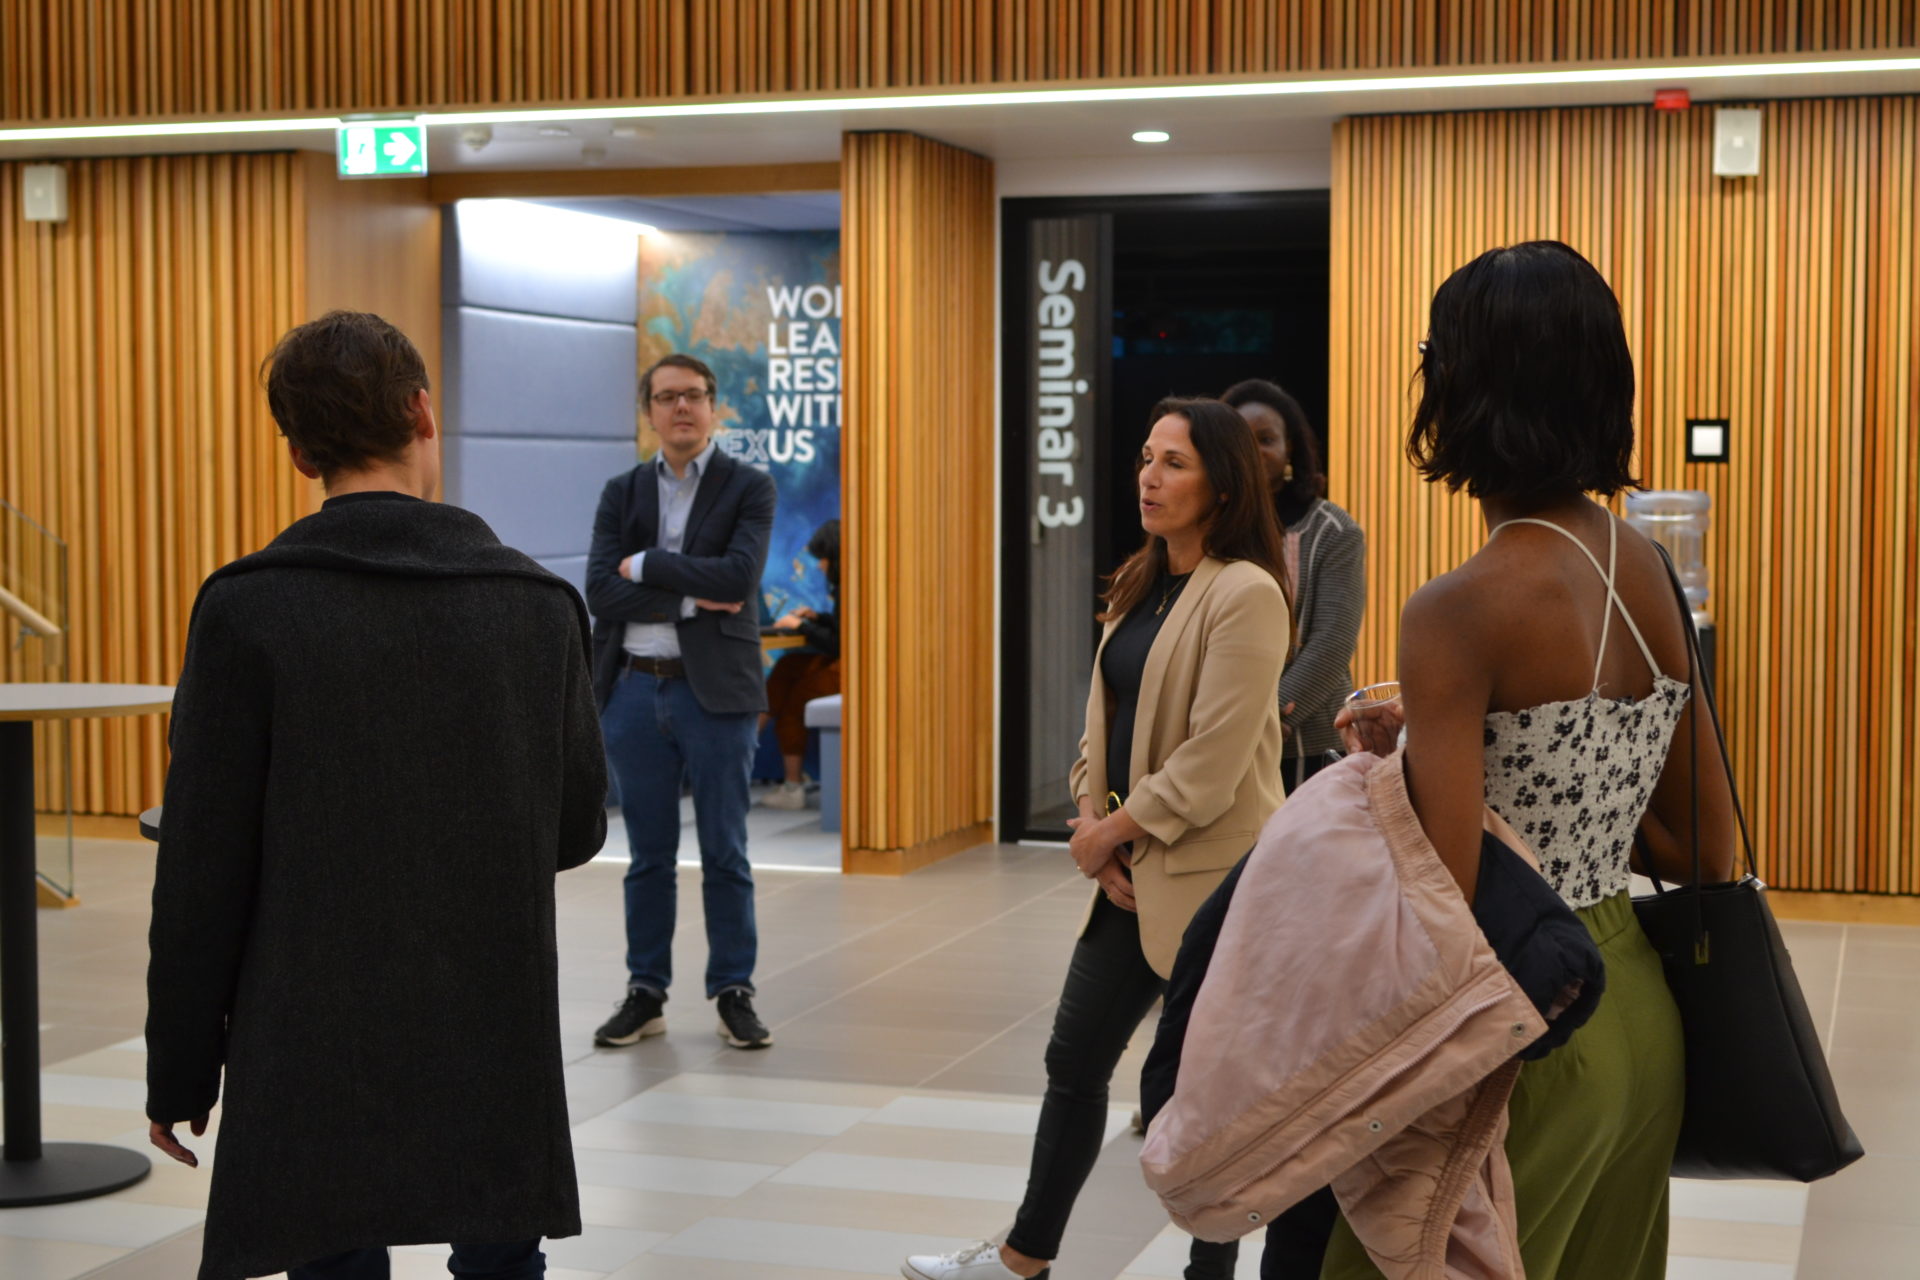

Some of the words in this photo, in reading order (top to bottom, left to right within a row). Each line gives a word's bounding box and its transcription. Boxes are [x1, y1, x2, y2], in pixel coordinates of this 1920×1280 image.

[768, 322, 838, 355] LEA
[768, 357, 842, 391] RES
[1037, 259, 1088, 486] Seminar
[1037, 495, 1084, 528] 3
